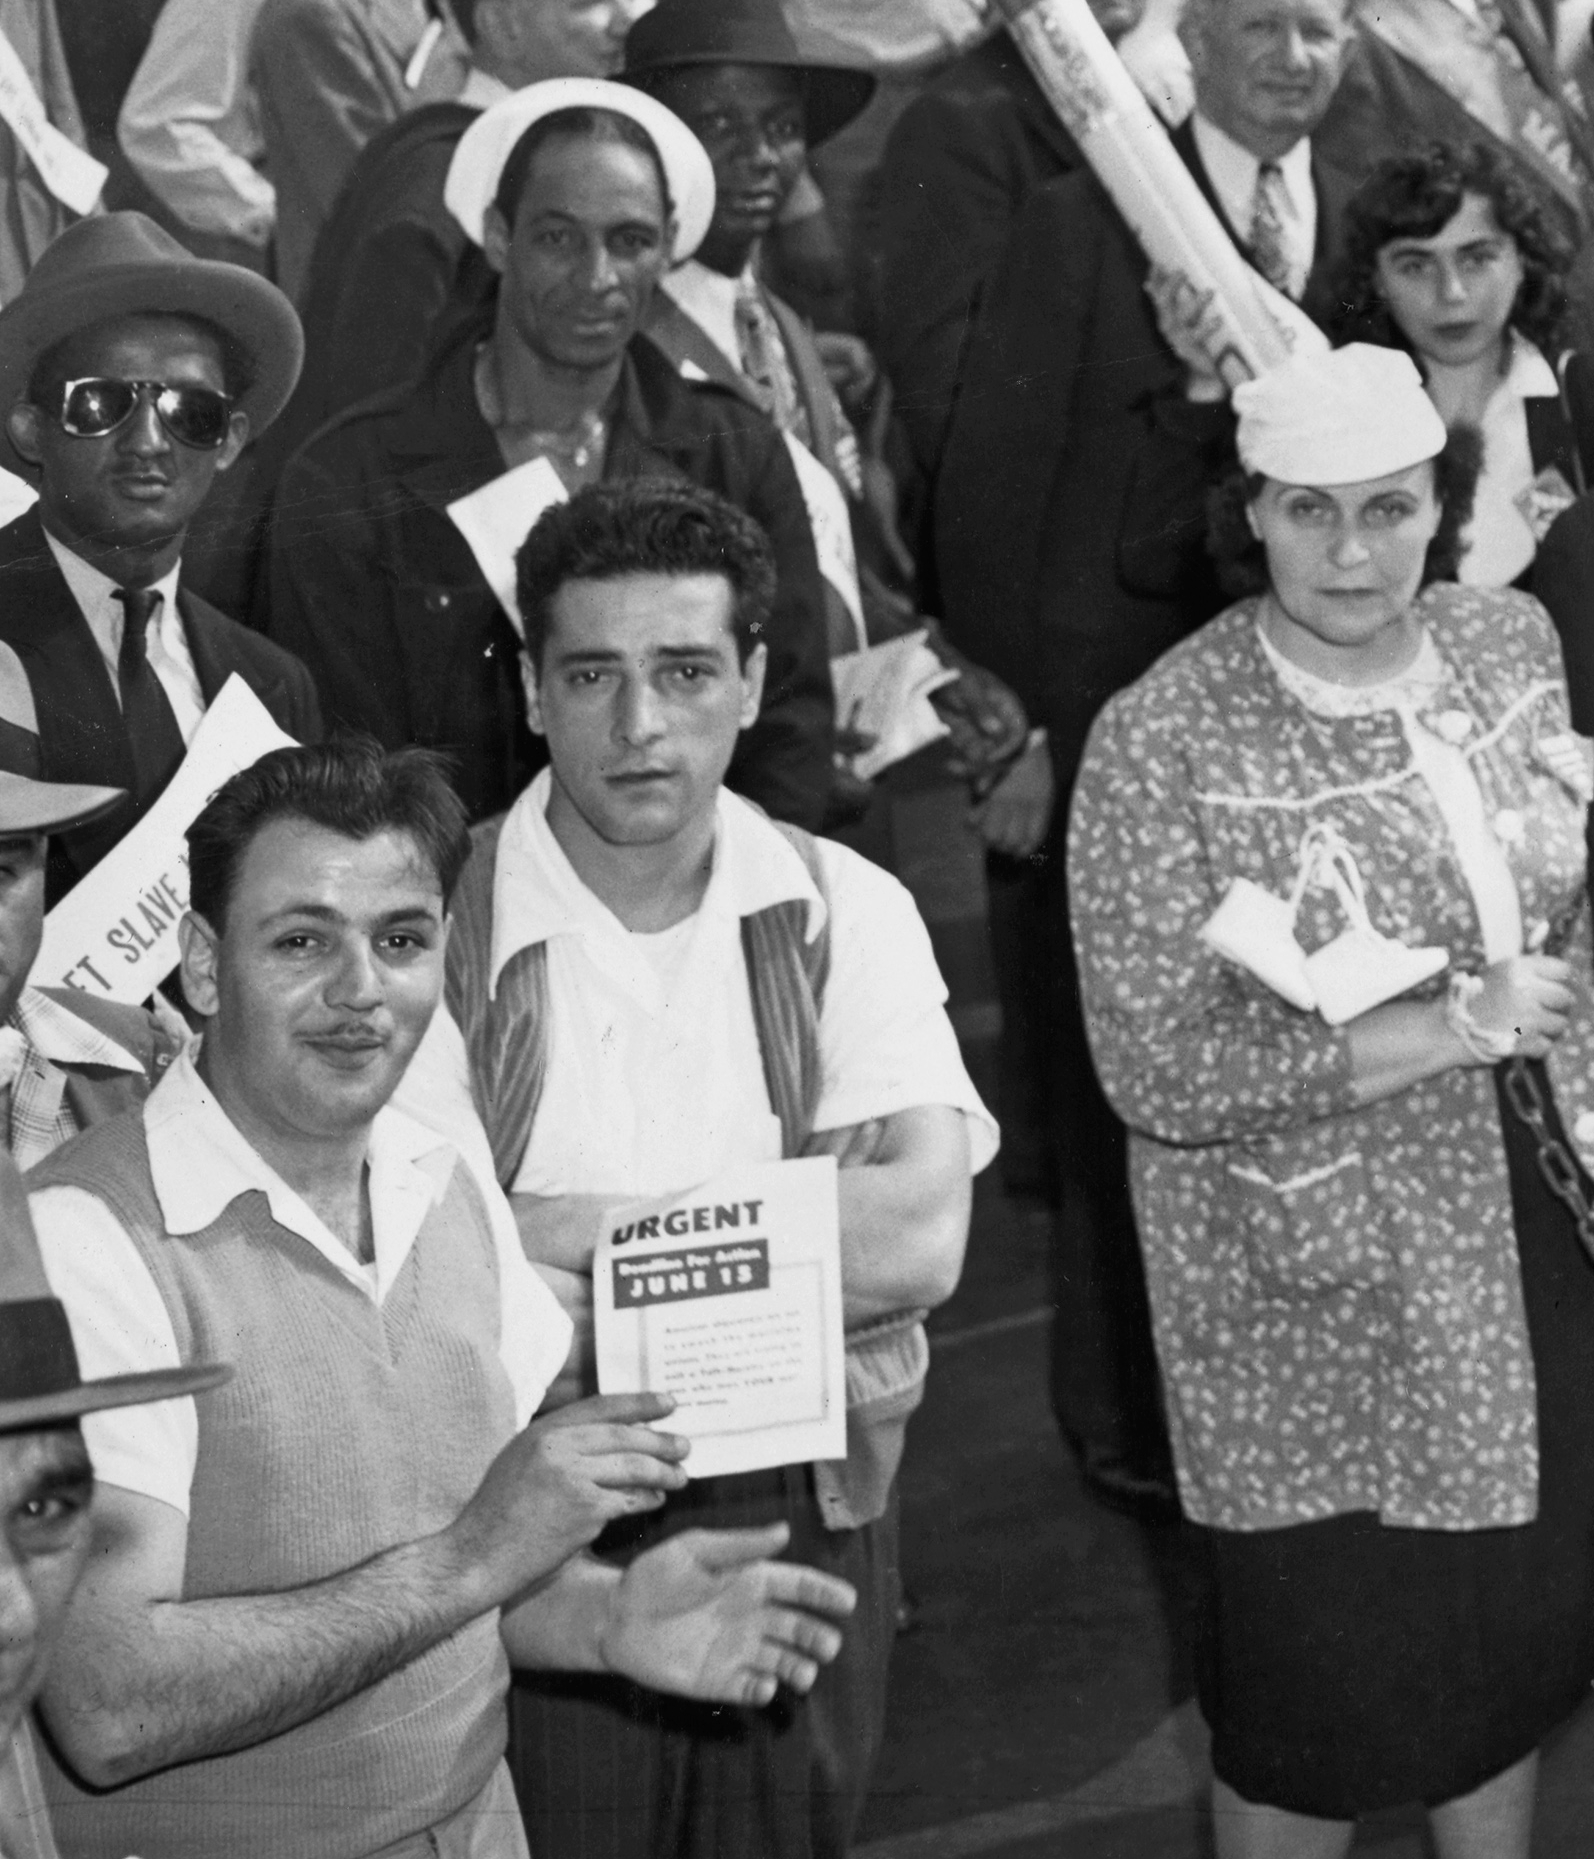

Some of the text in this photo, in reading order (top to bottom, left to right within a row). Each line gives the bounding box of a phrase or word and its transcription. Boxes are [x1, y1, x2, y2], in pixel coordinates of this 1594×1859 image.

[106, 872, 190, 964] SLAVE
[611, 1200, 764, 1245] URGENT
[629, 1269, 708, 1298] JUNE
